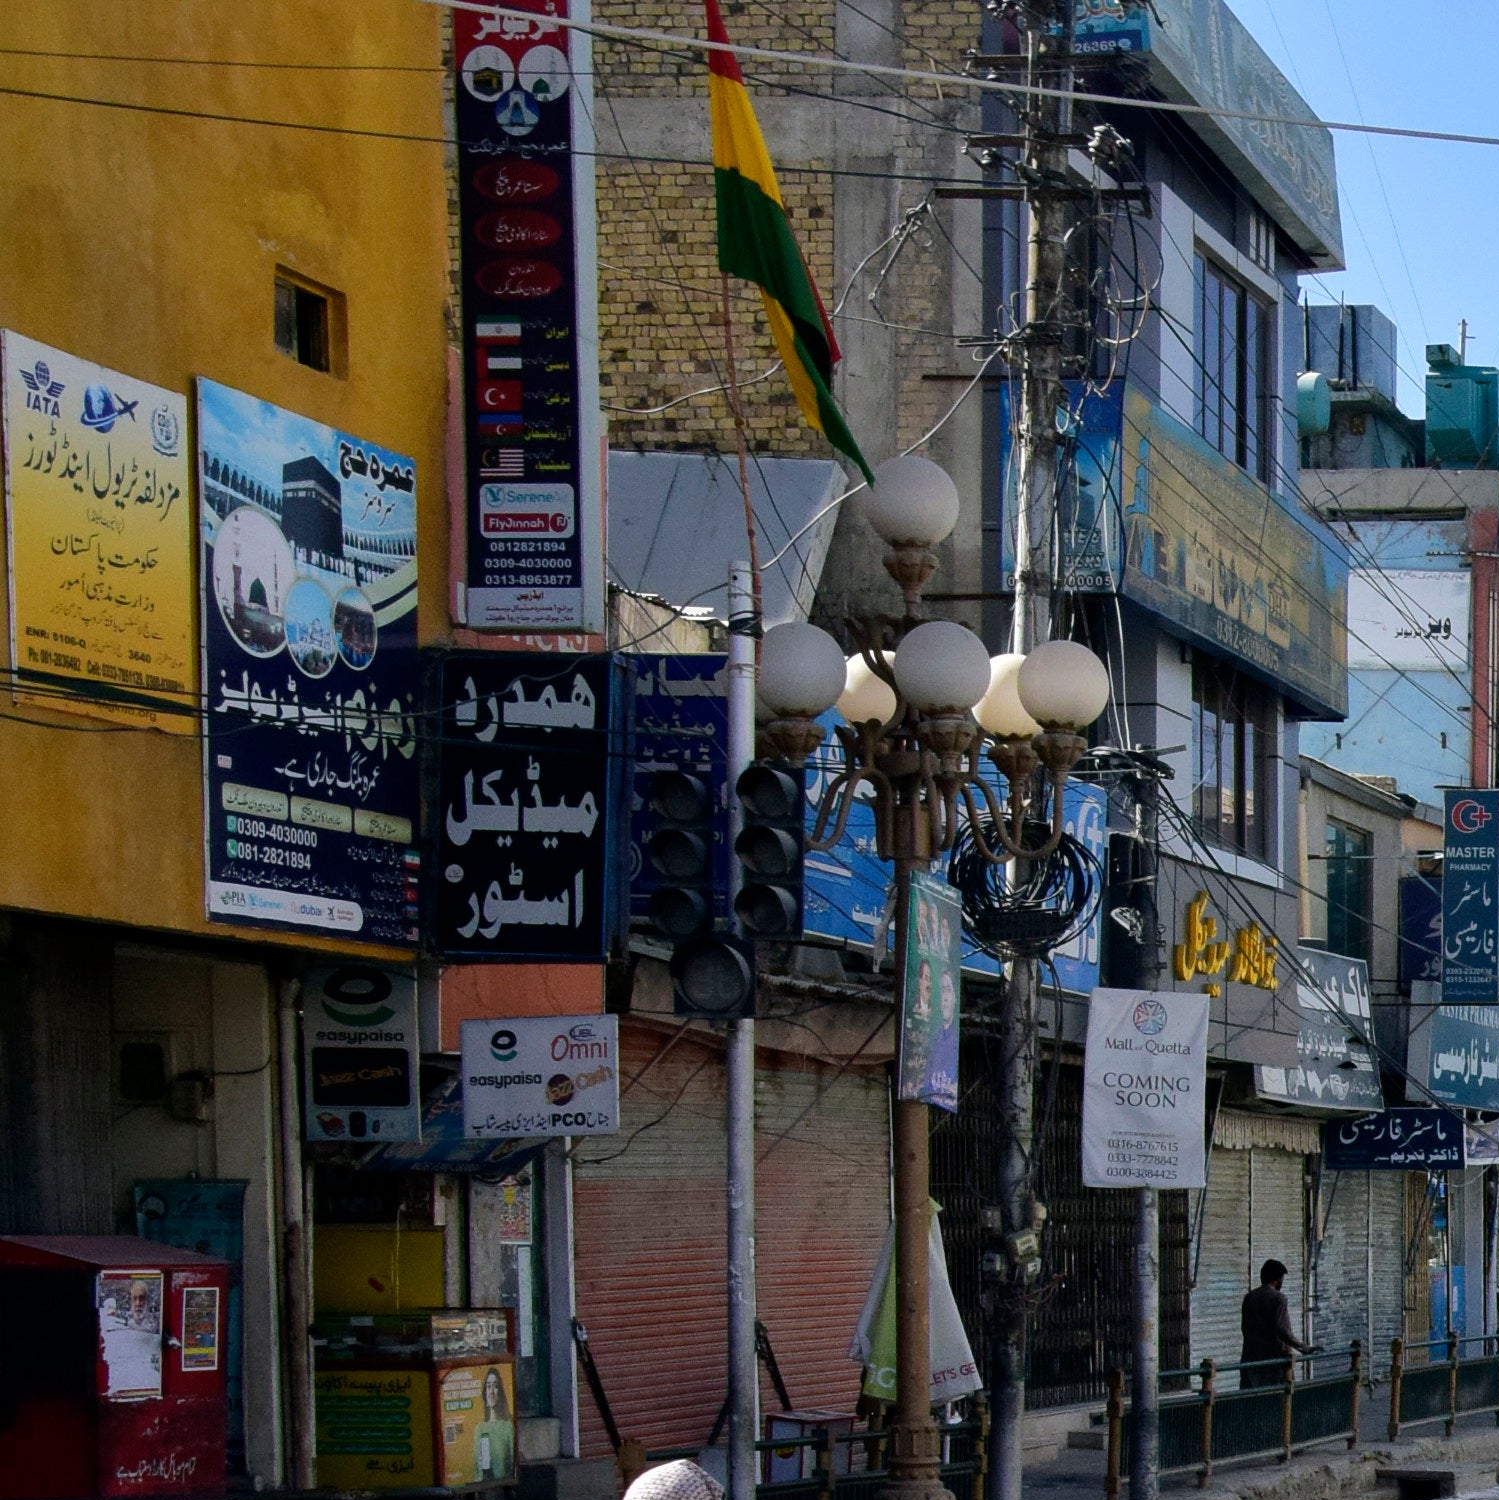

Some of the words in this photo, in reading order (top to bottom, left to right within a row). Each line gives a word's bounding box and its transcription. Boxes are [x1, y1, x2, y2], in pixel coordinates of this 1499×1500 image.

[27, 392, 60, 418] IATA
[23, 420, 57, 473] ٹورز
[339, 441, 370, 480] حج
[58, 432, 90, 493] اینڈ
[93, 442, 138, 509] ٹریول
[370, 453, 415, 493] عمرہ
[135, 469, 180, 521] مزدلفہ
[489, 518, 544, 530] FlyJinnah
[51, 533, 105, 575] پاکستان
[108, 547, 159, 574] حکومت
[490, 542, 566, 552] 0812821894
[484, 558, 572, 569] 0309-4030000
[485, 575, 572, 585] 0313-8963877
[455, 672, 596, 742] ہمدرد
[307, 751, 337, 797] جاری
[361, 765, 381, 801] عمرہ
[446, 755, 599, 847] میڈیکل
[237, 818, 318, 848] 0309-4030000
[237, 841, 311, 870] 081-2821894
[1446, 847, 1495, 858] MASTER
[1450, 863, 1491, 872] PHARMACY
[456, 862, 584, 939] اسٹور
[1450, 881, 1492, 916] ماسٹر
[1445, 920, 1497, 963] فارمیسی
[316, 1029, 404, 1045] easypaisa
[550, 1034, 609, 1062] Omni
[1105, 1037, 1134, 1051] Mall
[1145, 1039, 1191, 1056] Quetta
[469, 1071, 543, 1089] easypaisa
[1103, 1072, 1190, 1093] COMING
[1115, 1091, 1176, 1109] SOON
[552, 1113, 586, 1127] PCO
[1339, 1112, 1402, 1145] فارمیسی
[1400, 1118, 1448, 1148] ماسٹر
[1108, 1138, 1179, 1152] 0316-8767615
[1427, 1148, 1459, 1162] ڈاکٹر
